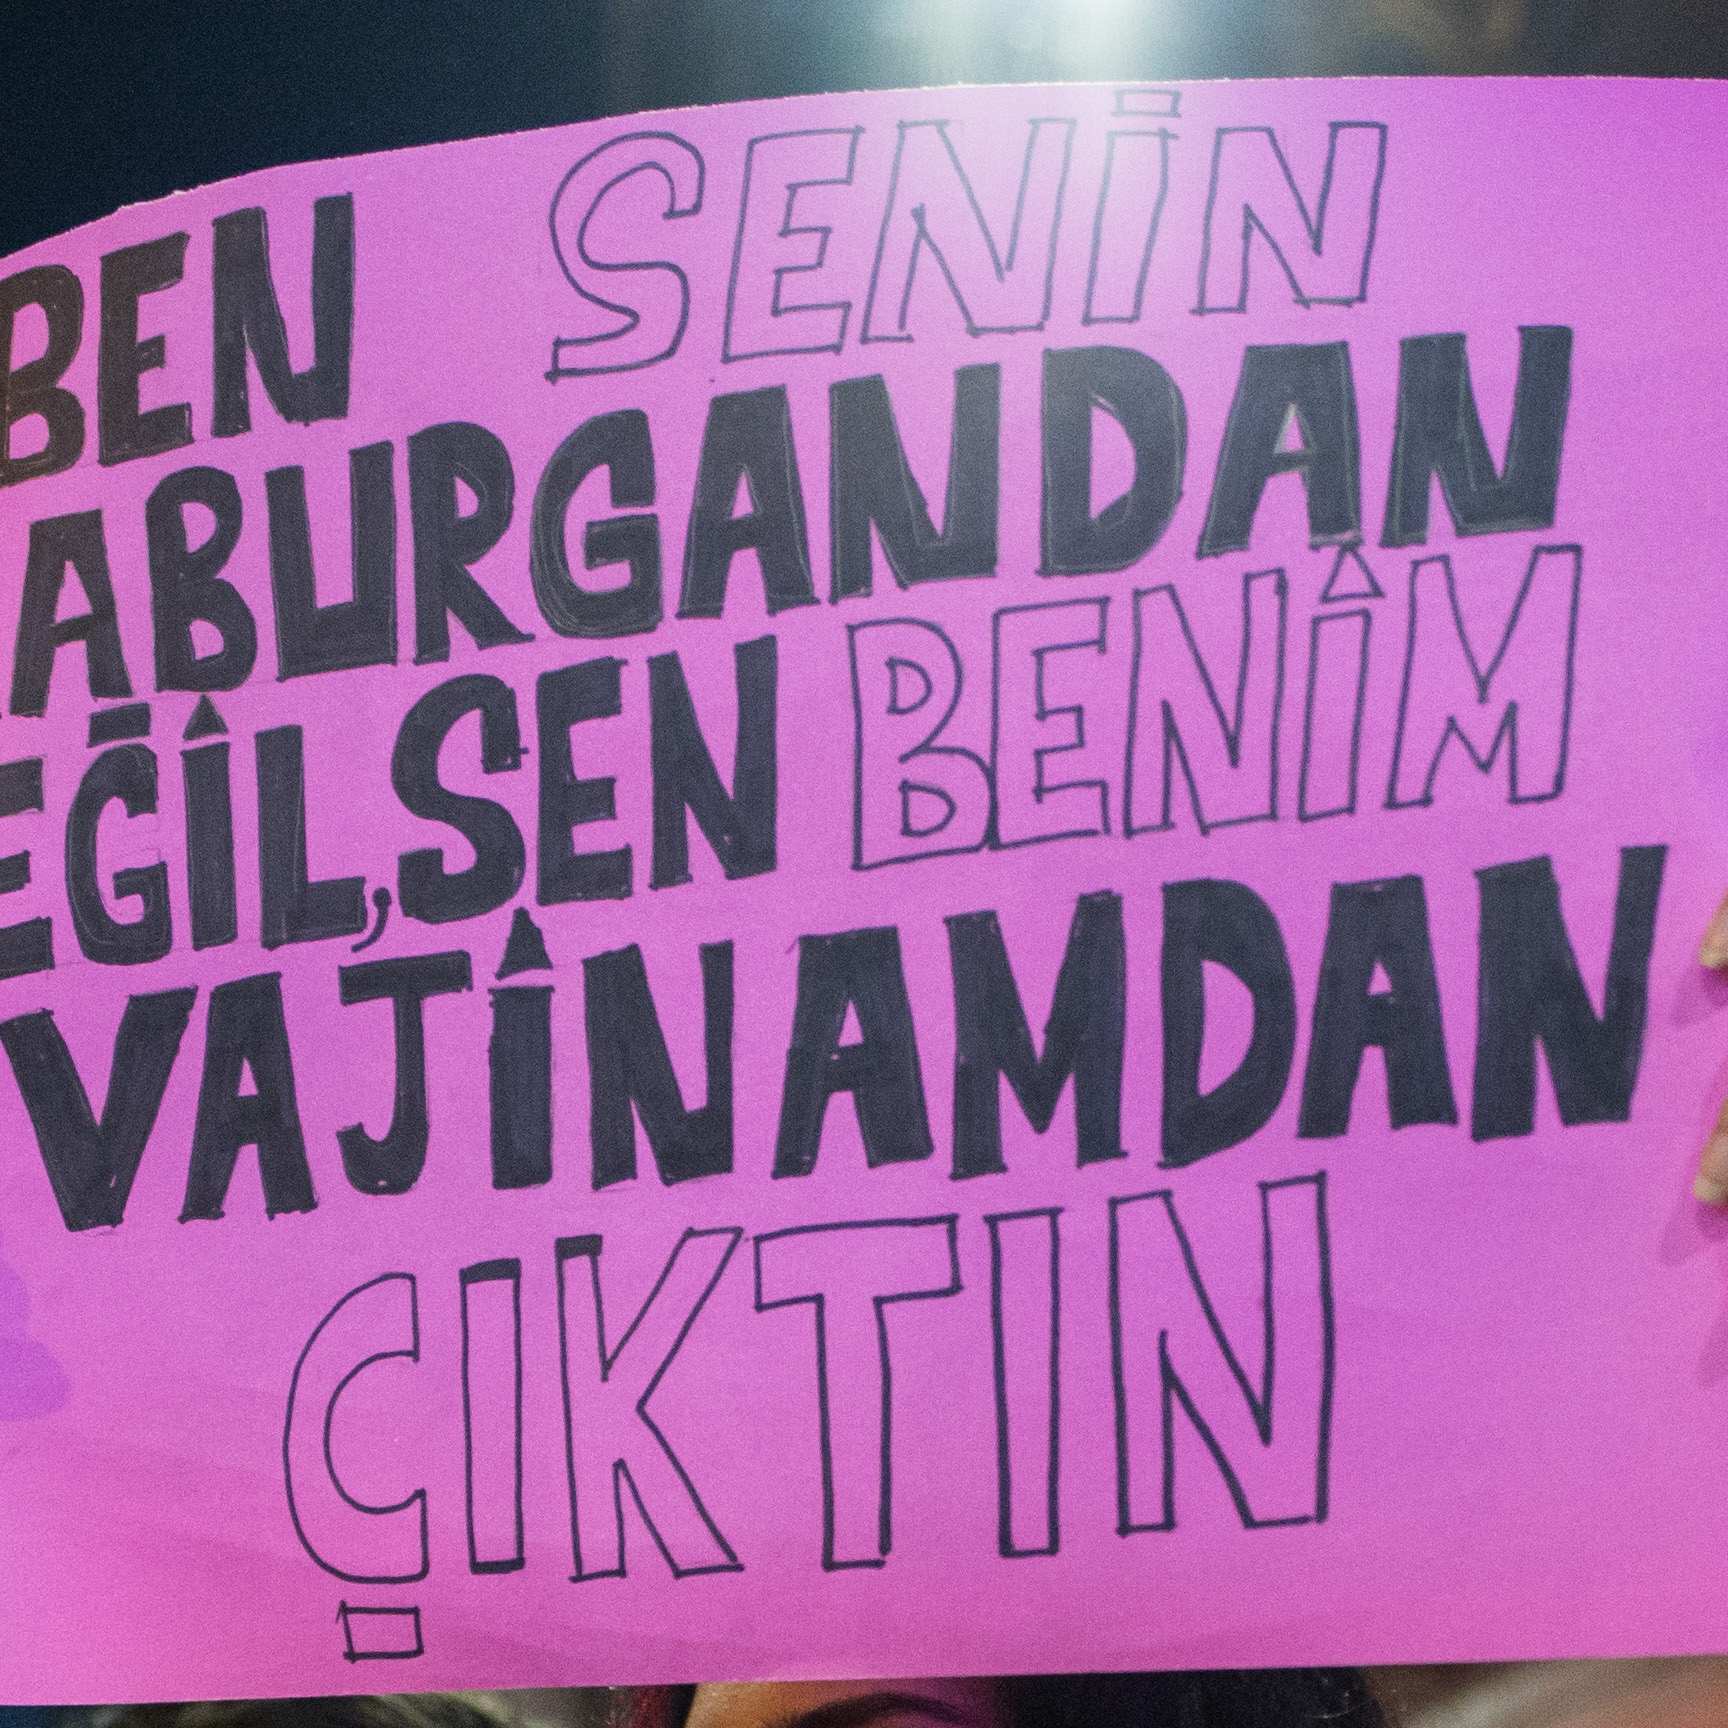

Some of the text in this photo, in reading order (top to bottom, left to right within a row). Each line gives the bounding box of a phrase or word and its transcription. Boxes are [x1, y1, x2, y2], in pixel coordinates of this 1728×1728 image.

[544, 88, 1388, 384] SENİN
[848, 541, 1583, 870] BENİM
[283, 1171, 1335, 1663] ÇIKTIN
